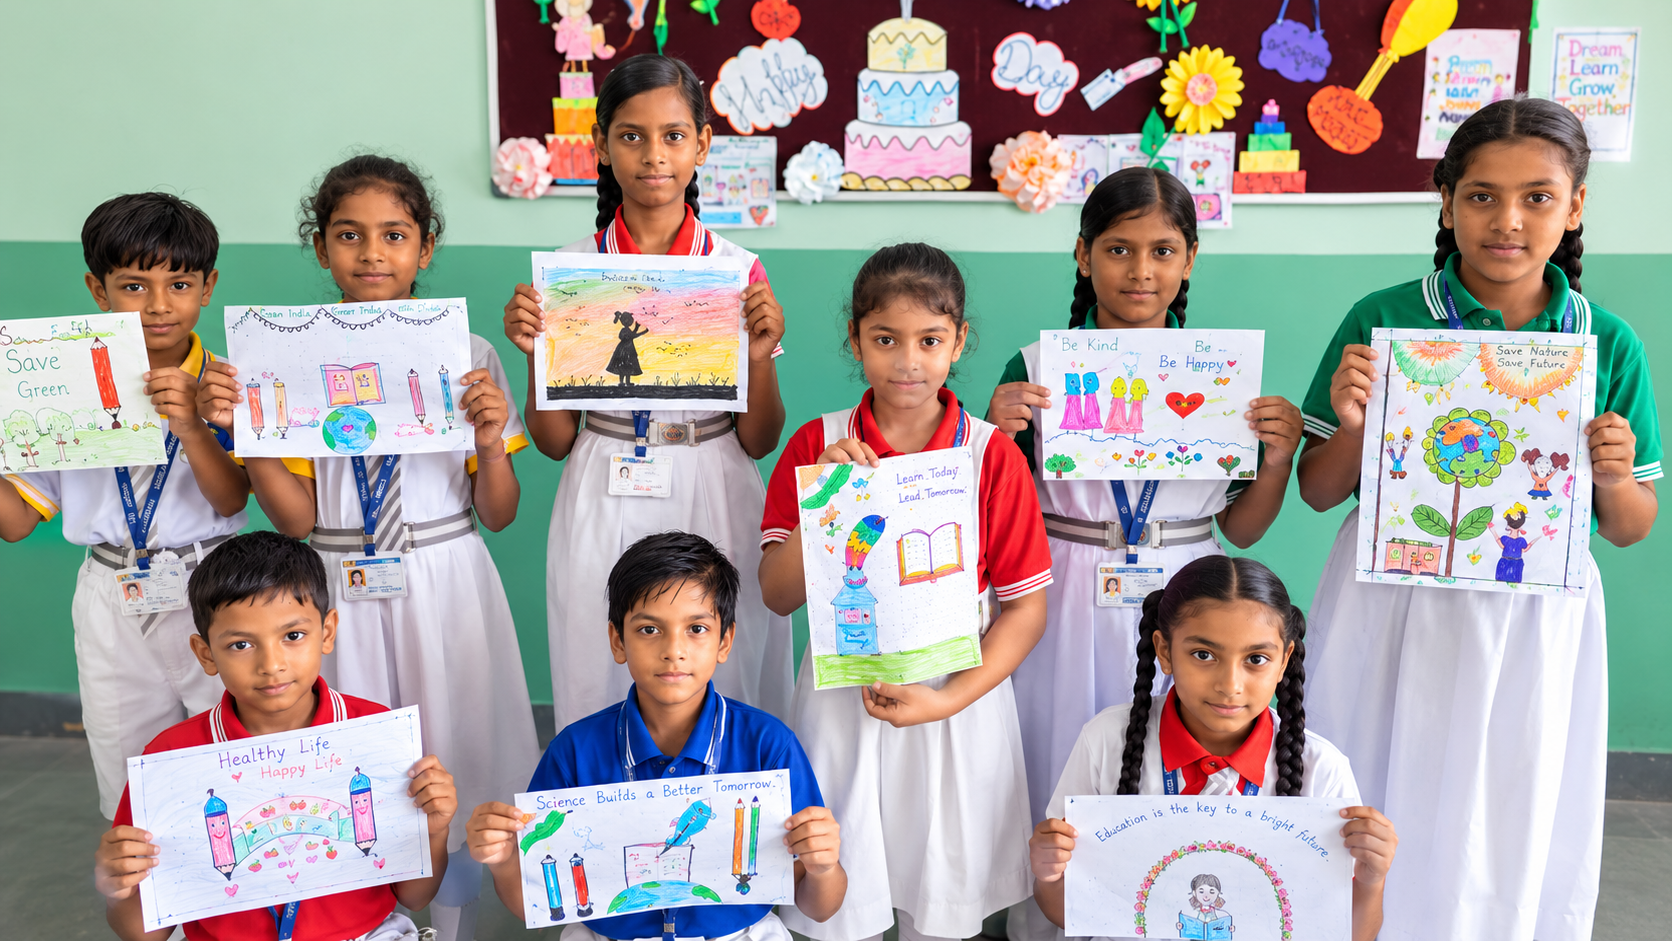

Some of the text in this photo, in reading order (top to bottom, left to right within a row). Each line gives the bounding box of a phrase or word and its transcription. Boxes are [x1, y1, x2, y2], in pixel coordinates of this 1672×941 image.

[1569, 39, 1623, 58] Dream
[998, 39, 1069, 110] Day
[1569, 59, 1619, 76] Learn
[1569, 77, 1615, 96] Grow
[1556, 97, 1631, 122] Together
[1062, 337, 1118, 351] Be Kind
[1195, 340, 1211, 353] Be
[1496, 345, 1568, 357] Save Nature
[6, 349, 61, 374] Save
[1159, 355, 1224, 374] Be Happy
[1497, 357, 1566, 369] Save Future
[17, 380, 70, 398] Green
[896, 466, 959, 485] Learn Today
[898, 489, 921, 503] Lead
[218, 736, 330, 769] Healthy Life
[261, 753, 342, 780] Happy Life
[536, 795, 586, 810] Science
[597, 788, 637, 804] Builds
[663, 784, 703, 797] Better
[1095, 814, 1148, 842] Education
[1152, 808, 1163, 818] is
[1170, 802, 1189, 814] the
[1196, 801, 1217, 817] key
[1225, 803, 1237, 814] to
[1260, 810, 1295, 831] bright
